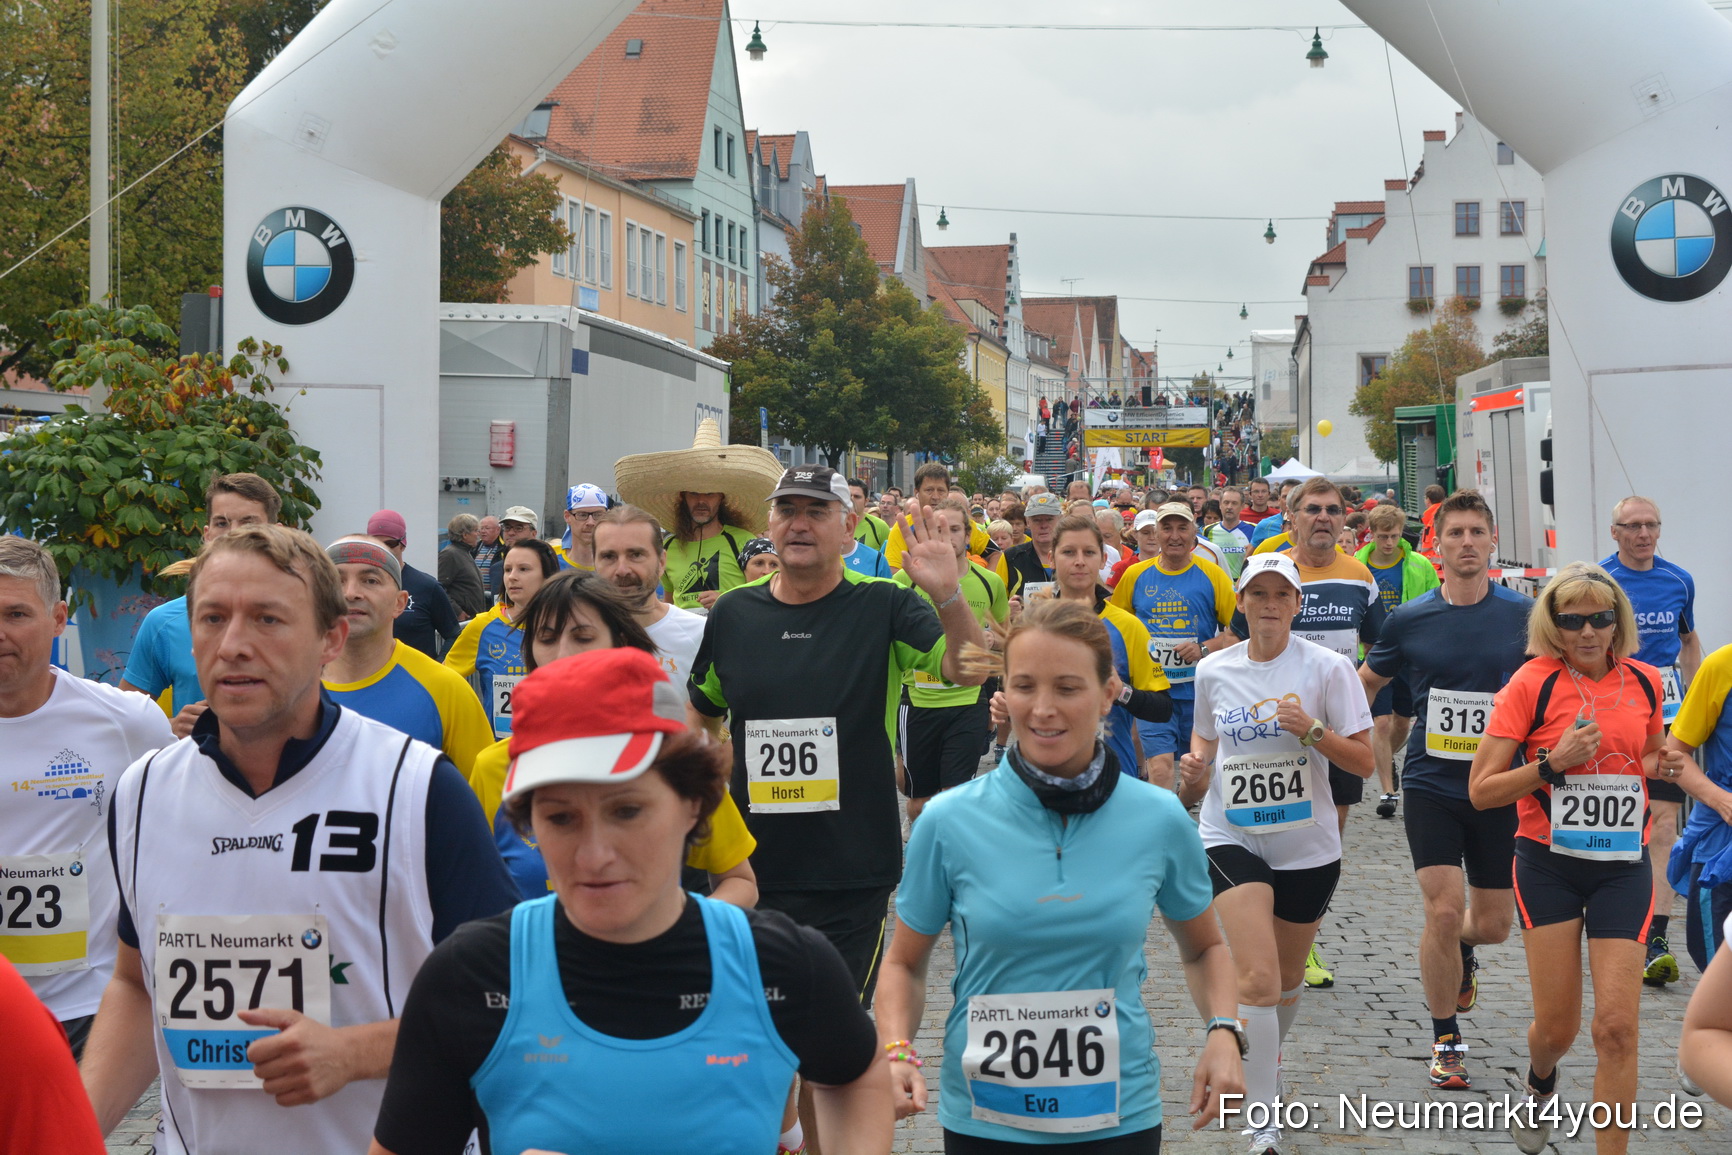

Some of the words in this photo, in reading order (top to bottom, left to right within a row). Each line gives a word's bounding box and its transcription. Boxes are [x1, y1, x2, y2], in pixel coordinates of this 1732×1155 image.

[1621, 177, 1728, 221] BMW
[254, 209, 346, 248] BMW
[1125, 432, 1168, 443] START
[1305, 633, 1325, 641] Gute
[1429, 694, 1452, 704] PARTL
[1453, 697, 1489, 706] Neumarkt
[1216, 706, 1260, 727] NEW
[1440, 706, 1486, 735] 313
[746, 729, 771, 738] PARTL
[772, 728, 818, 738] Neumarkt
[1443, 738, 1478, 751] Florian
[760, 741, 818, 776] 296
[1223, 764, 1251, 772] PARTL
[1252, 760, 1295, 770] Neumarkt
[11, 780, 35, 792] 14.
[30, 776, 73, 785] Neumarkter
[1230, 770, 1305, 805] 2664
[1587, 783, 1629, 792] Neumarkt
[772, 786, 805, 800] Horst
[1253, 809, 1286, 823] Birgit
[1561, 795, 1637, 827] 2902
[211, 833, 283, 855] SPALDING
[291, 810, 379, 873] 13
[1586, 836, 1612, 848] Jina
[0, 866, 65, 878] Neumarkt
[158, 932, 206, 948] PARTL
[211, 933, 294, 948] Neumarkt
[169, 957, 304, 1021] 2571
[970, 1009, 1014, 1022] PARTL
[1017, 1006, 1089, 1020] Neumarkt
[706, 1053, 749, 1067] Margit
[980, 1025, 1105, 1080] 2646
[1024, 1094, 1059, 1113] Eva
